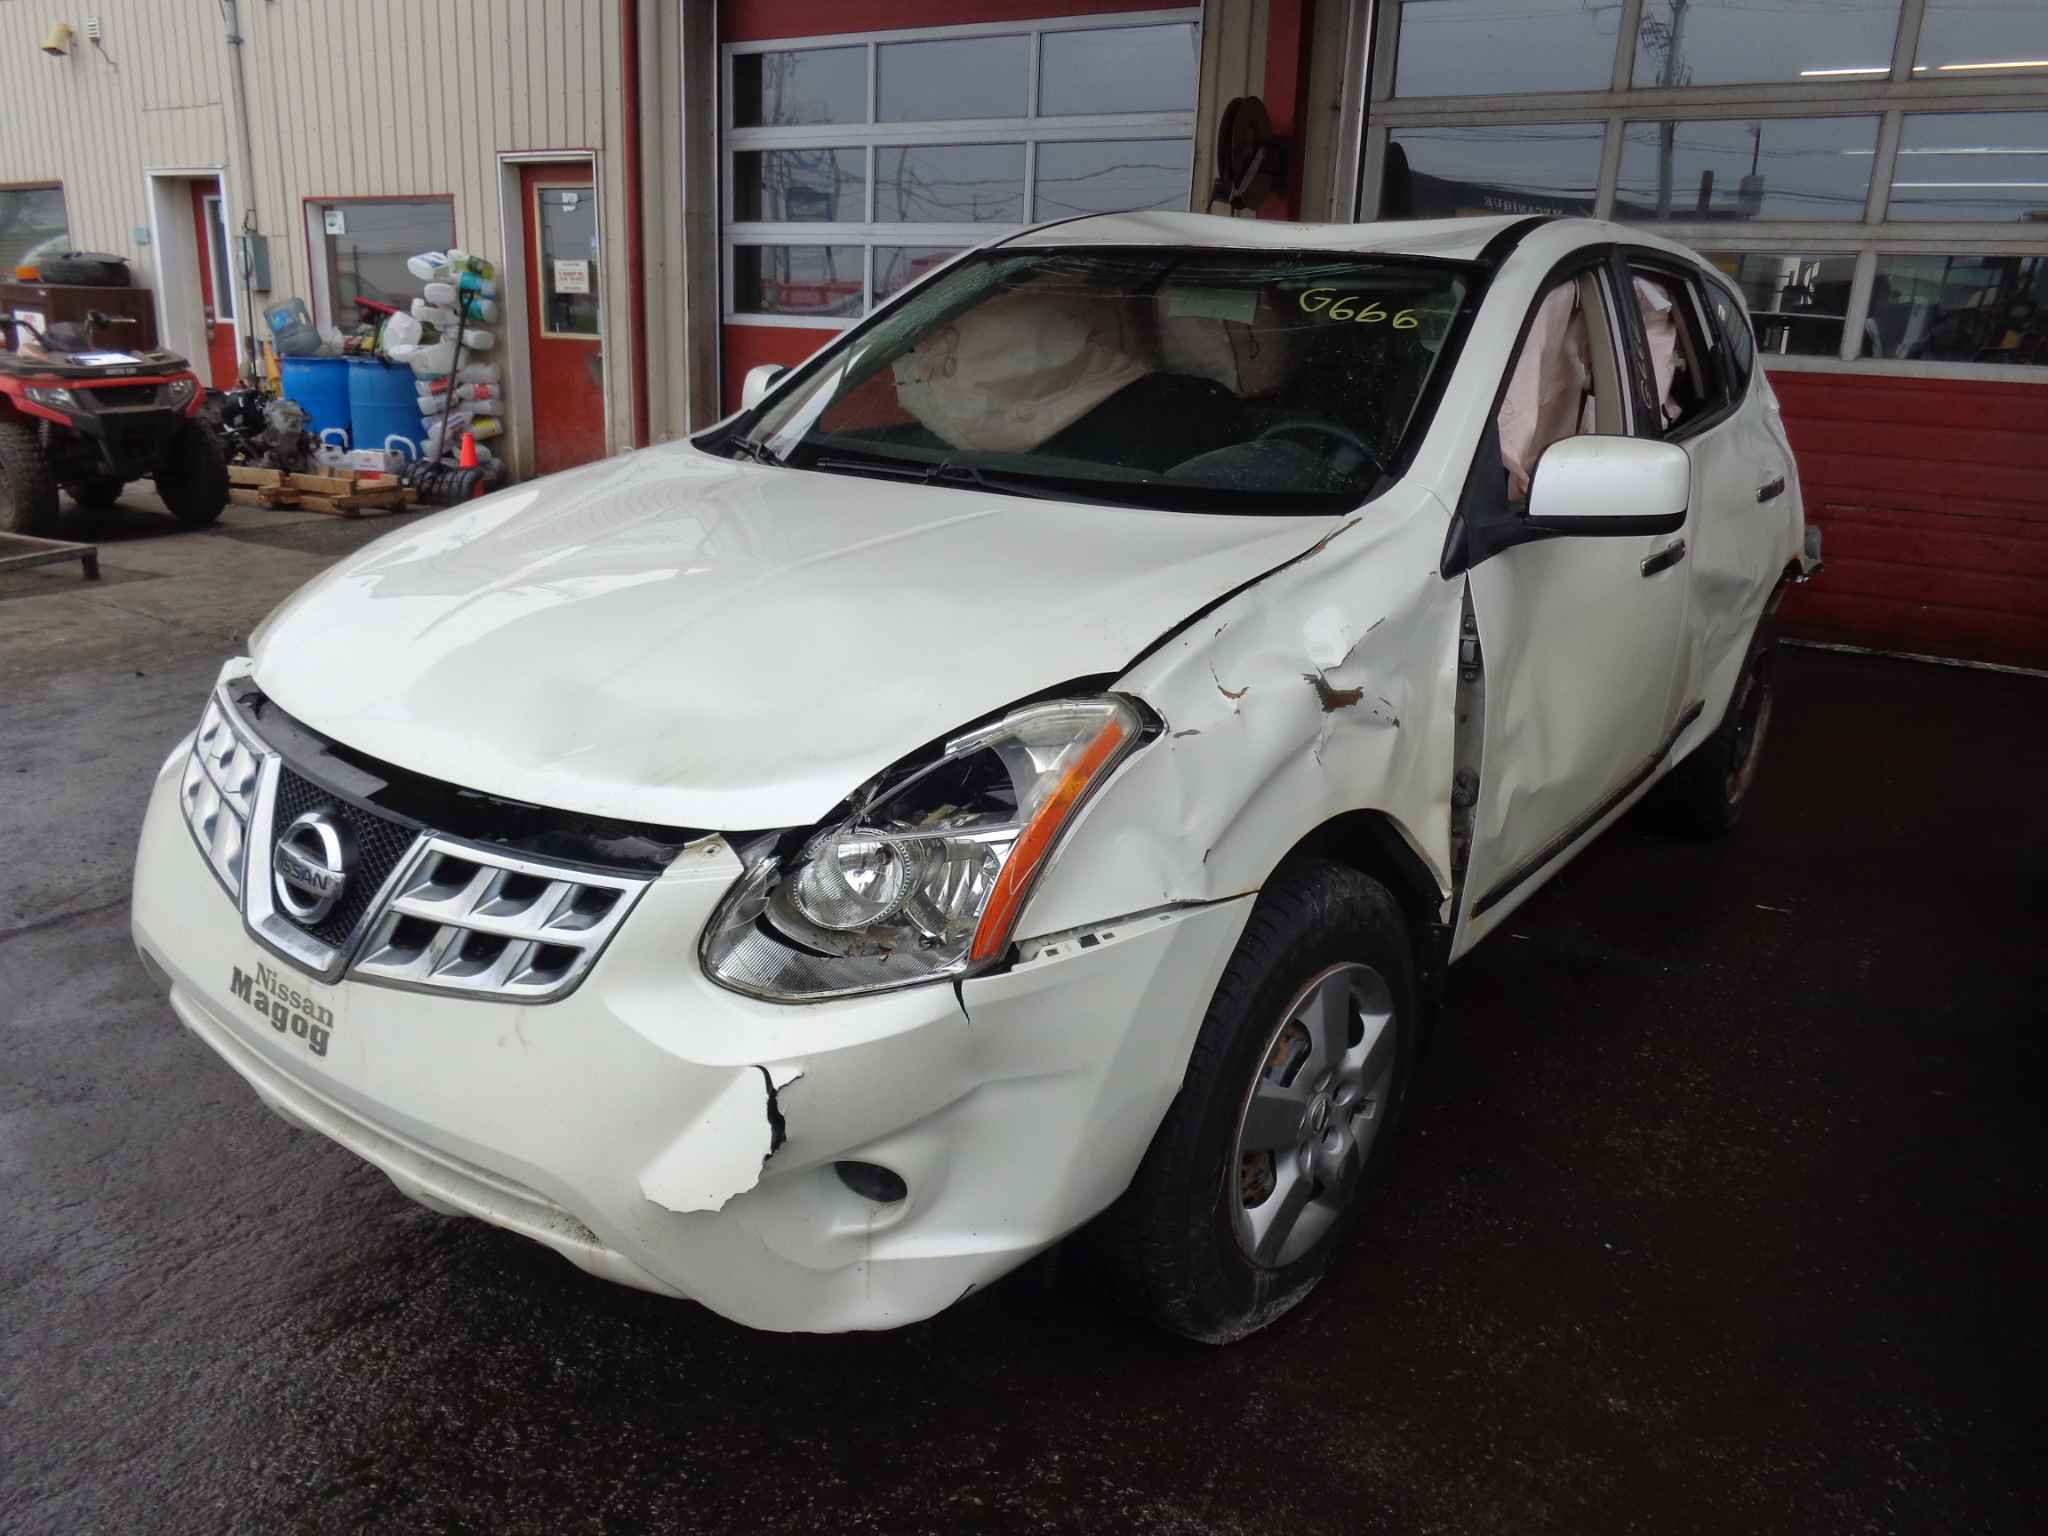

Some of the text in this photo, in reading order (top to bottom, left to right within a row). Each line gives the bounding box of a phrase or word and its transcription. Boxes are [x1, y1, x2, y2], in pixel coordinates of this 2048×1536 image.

[1300, 287, 1419, 329] G666
[230, 965, 331, 1057] Magog
[254, 961, 335, 1029] Nissan
